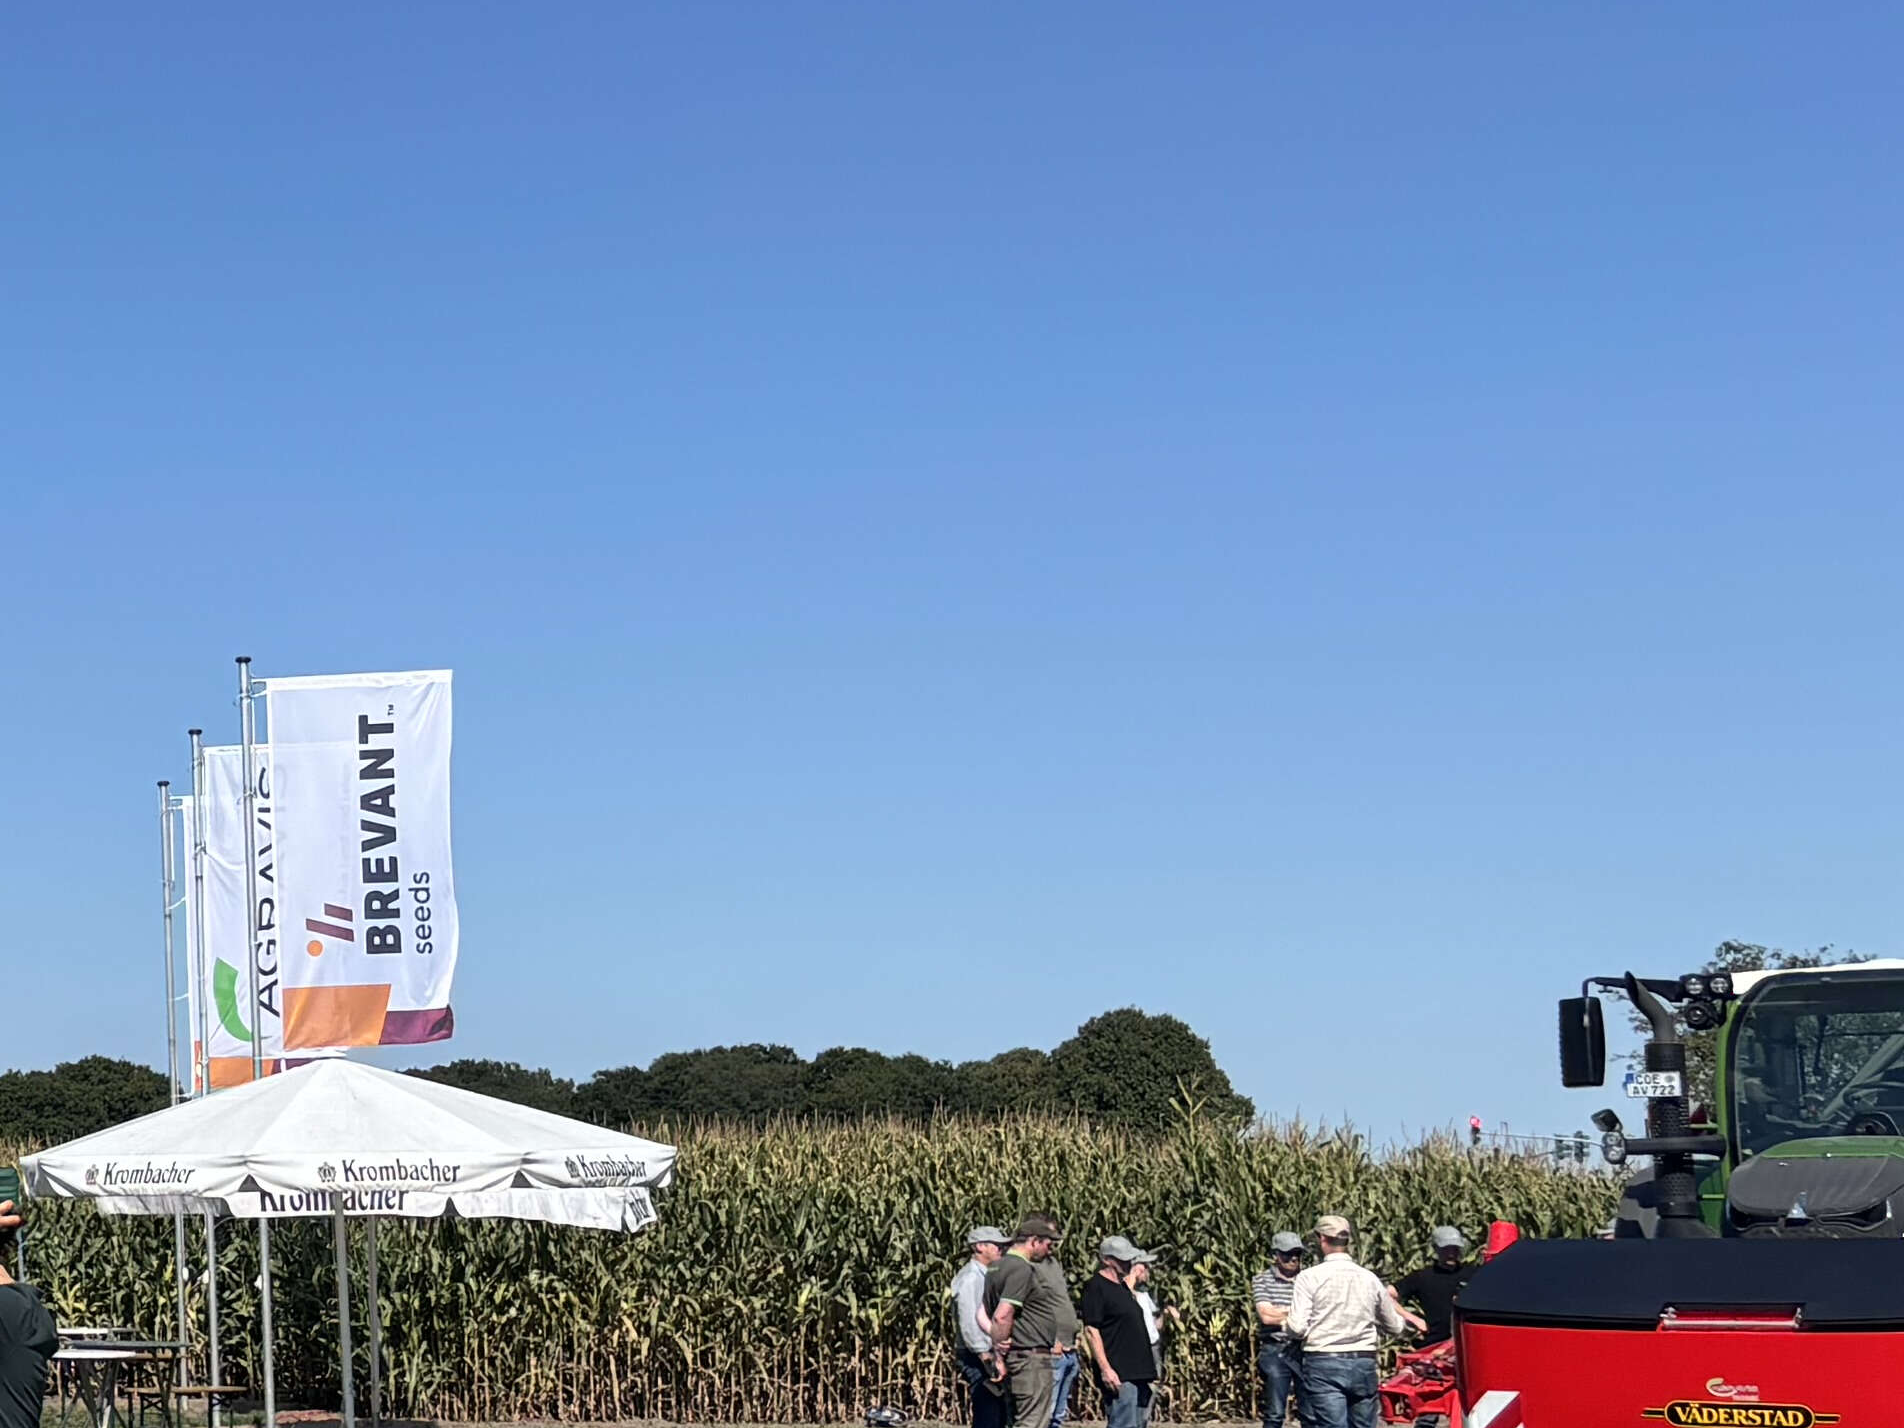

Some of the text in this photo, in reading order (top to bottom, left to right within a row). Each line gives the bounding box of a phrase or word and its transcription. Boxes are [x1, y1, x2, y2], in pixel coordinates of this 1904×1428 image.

[408, 871, 433, 955] seeds
[104, 1161, 195, 1185] Krombacher
[341, 1158, 461, 1183] Krombacher
[576, 1154, 647, 1179] Krombacher
[260, 1189, 409, 1213] Kromacher
[1674, 1403, 1805, 1427] VÄDERSTAD
